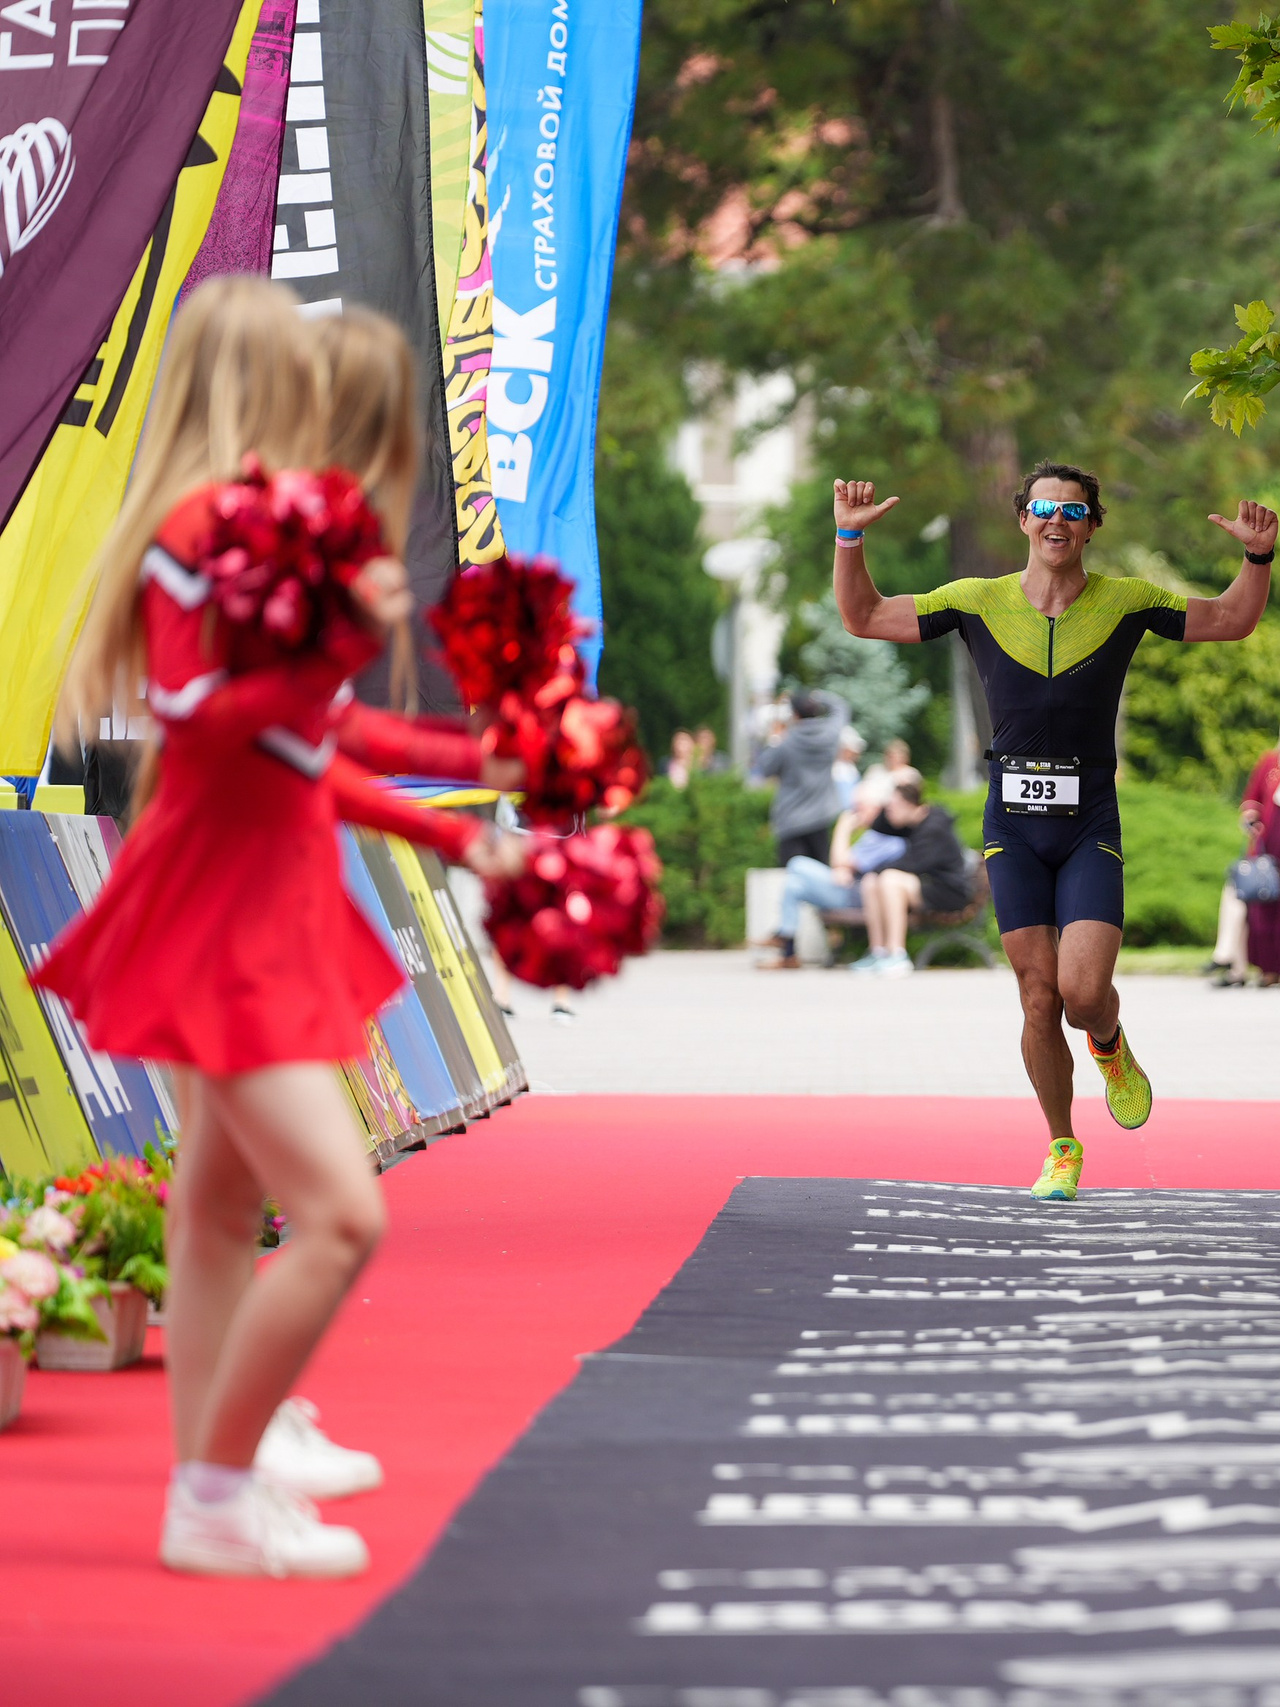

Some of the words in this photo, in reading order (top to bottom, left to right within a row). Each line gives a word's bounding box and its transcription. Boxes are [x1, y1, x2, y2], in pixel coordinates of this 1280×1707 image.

[532, 85, 563, 291] СТРАХОВОЙ
[486, 296, 557, 503] ВСК
[1020, 779, 1056, 800] 293
